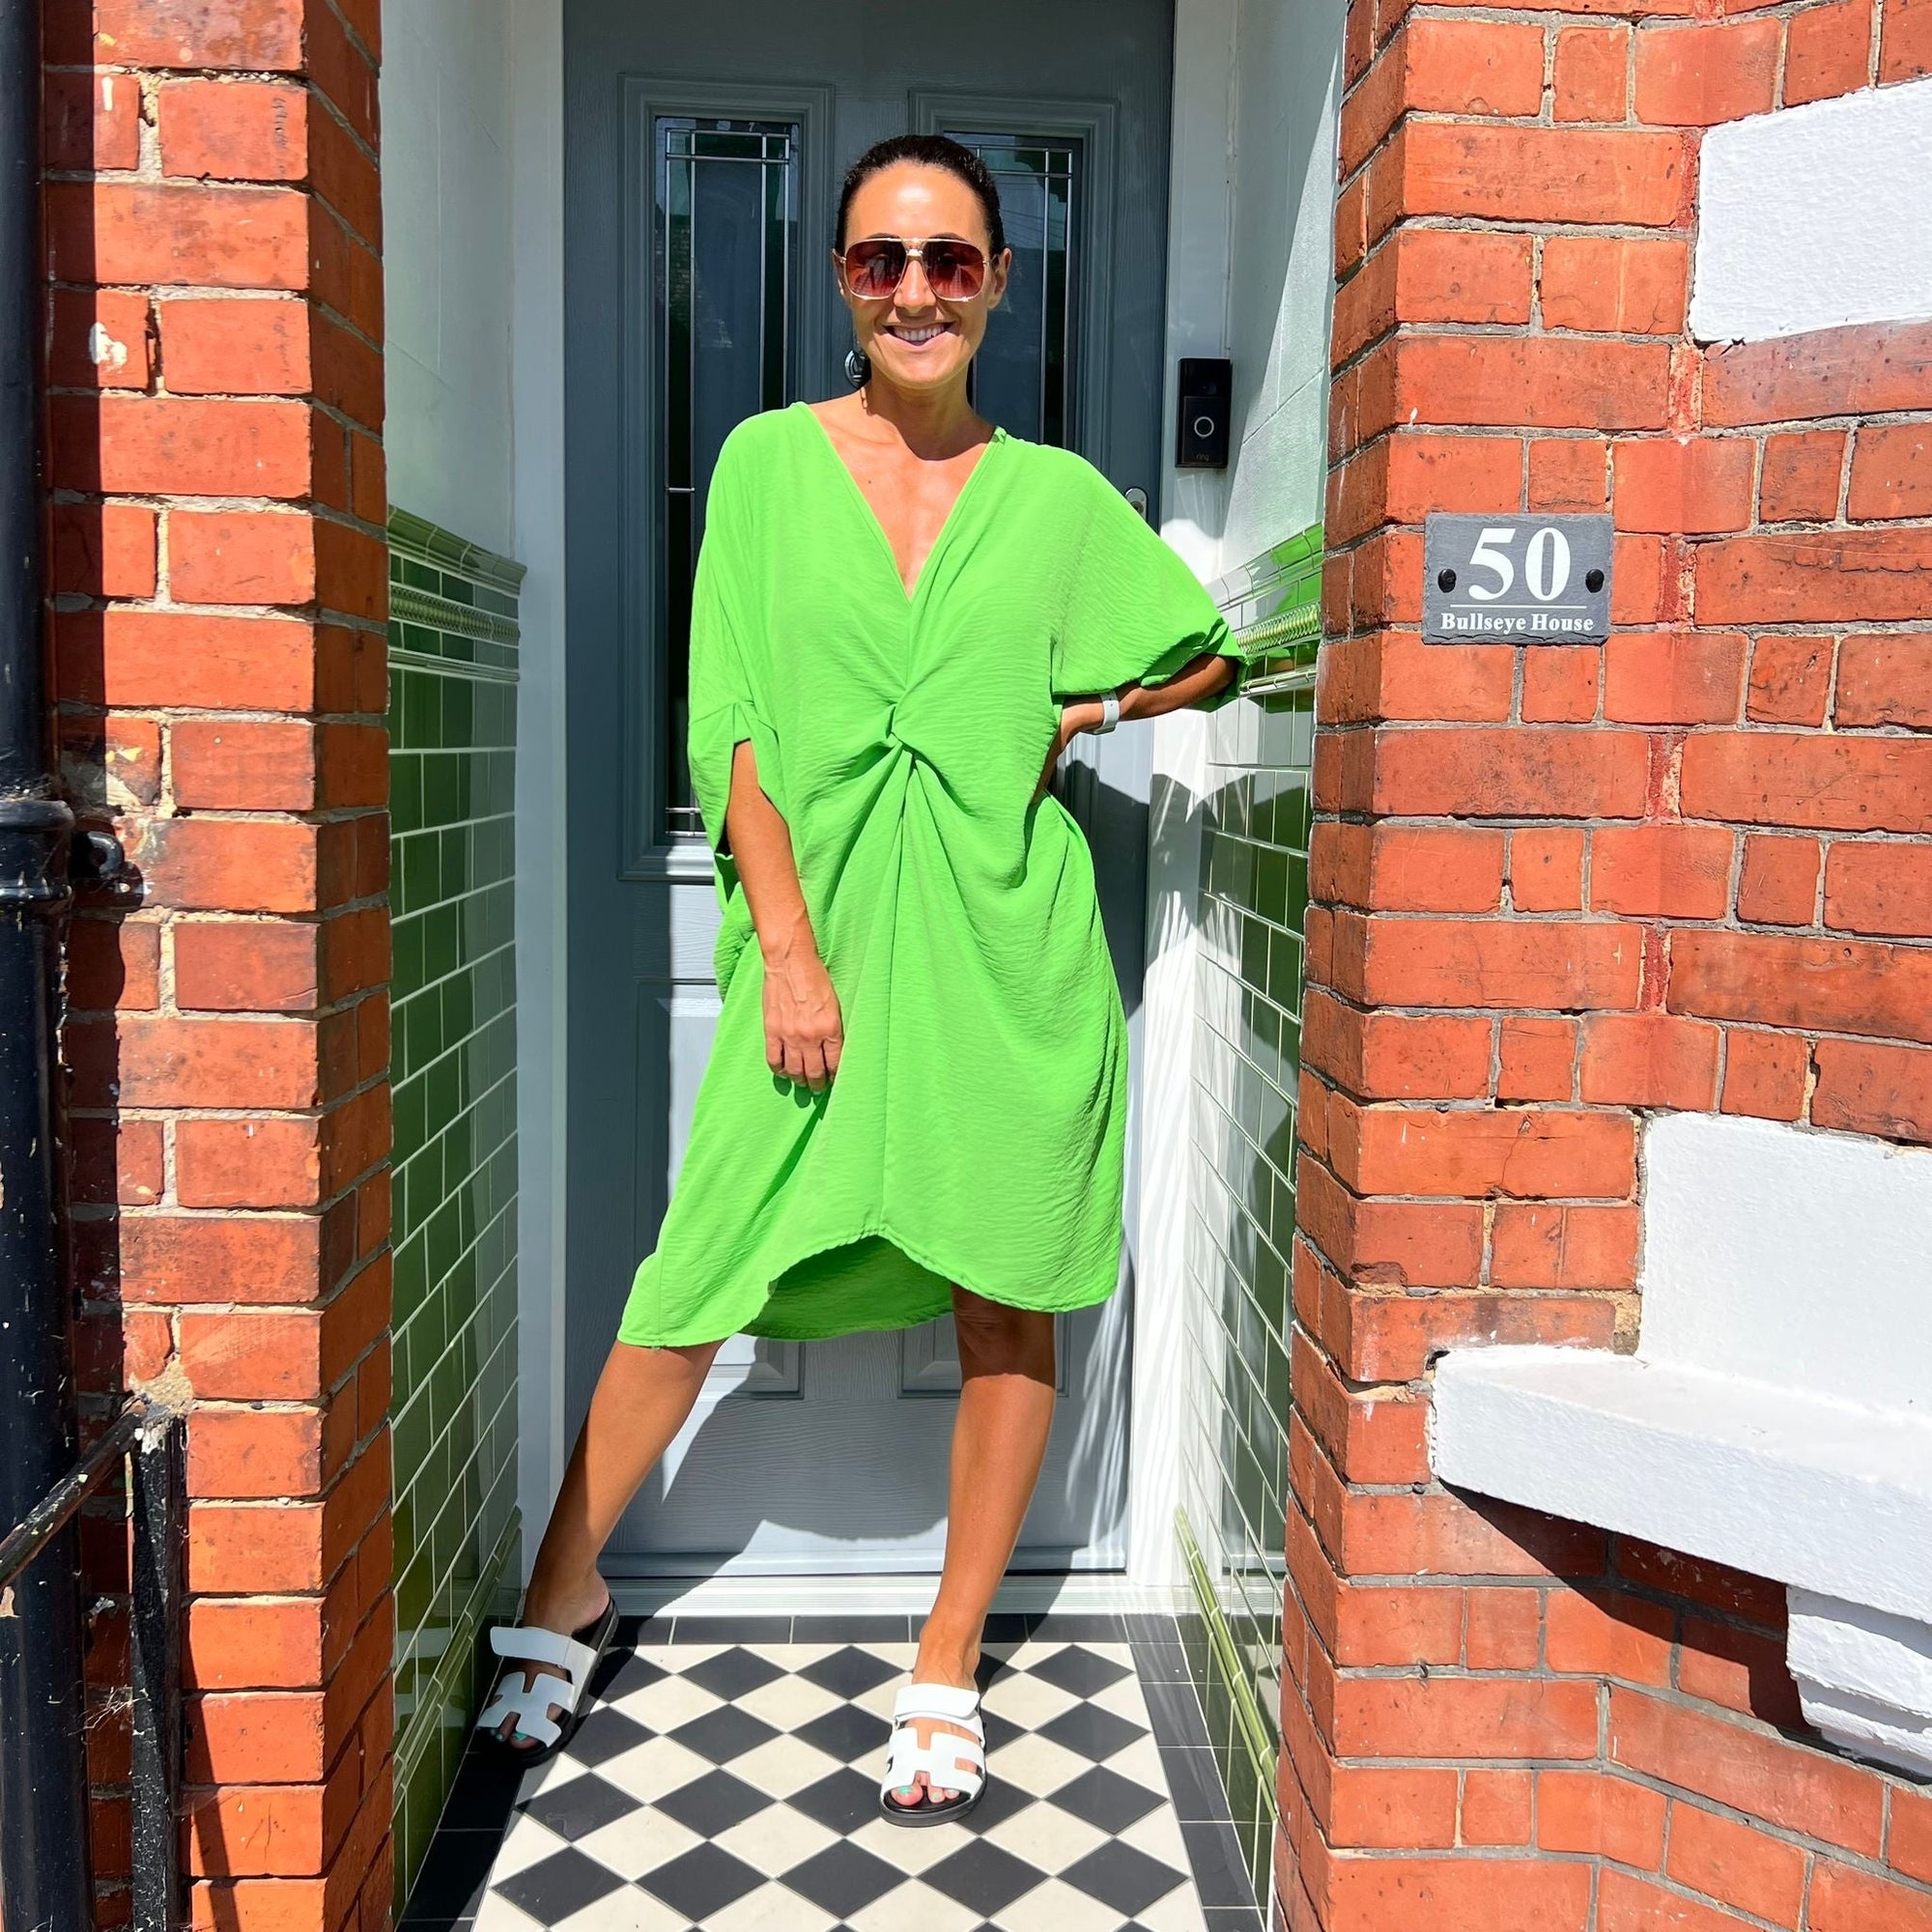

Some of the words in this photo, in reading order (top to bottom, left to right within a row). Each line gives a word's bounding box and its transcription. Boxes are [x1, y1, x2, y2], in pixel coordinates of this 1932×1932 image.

[1468, 527, 1571, 601] 50
[1440, 612, 1526, 634] Bullseye
[1531, 613, 1593, 631] House
